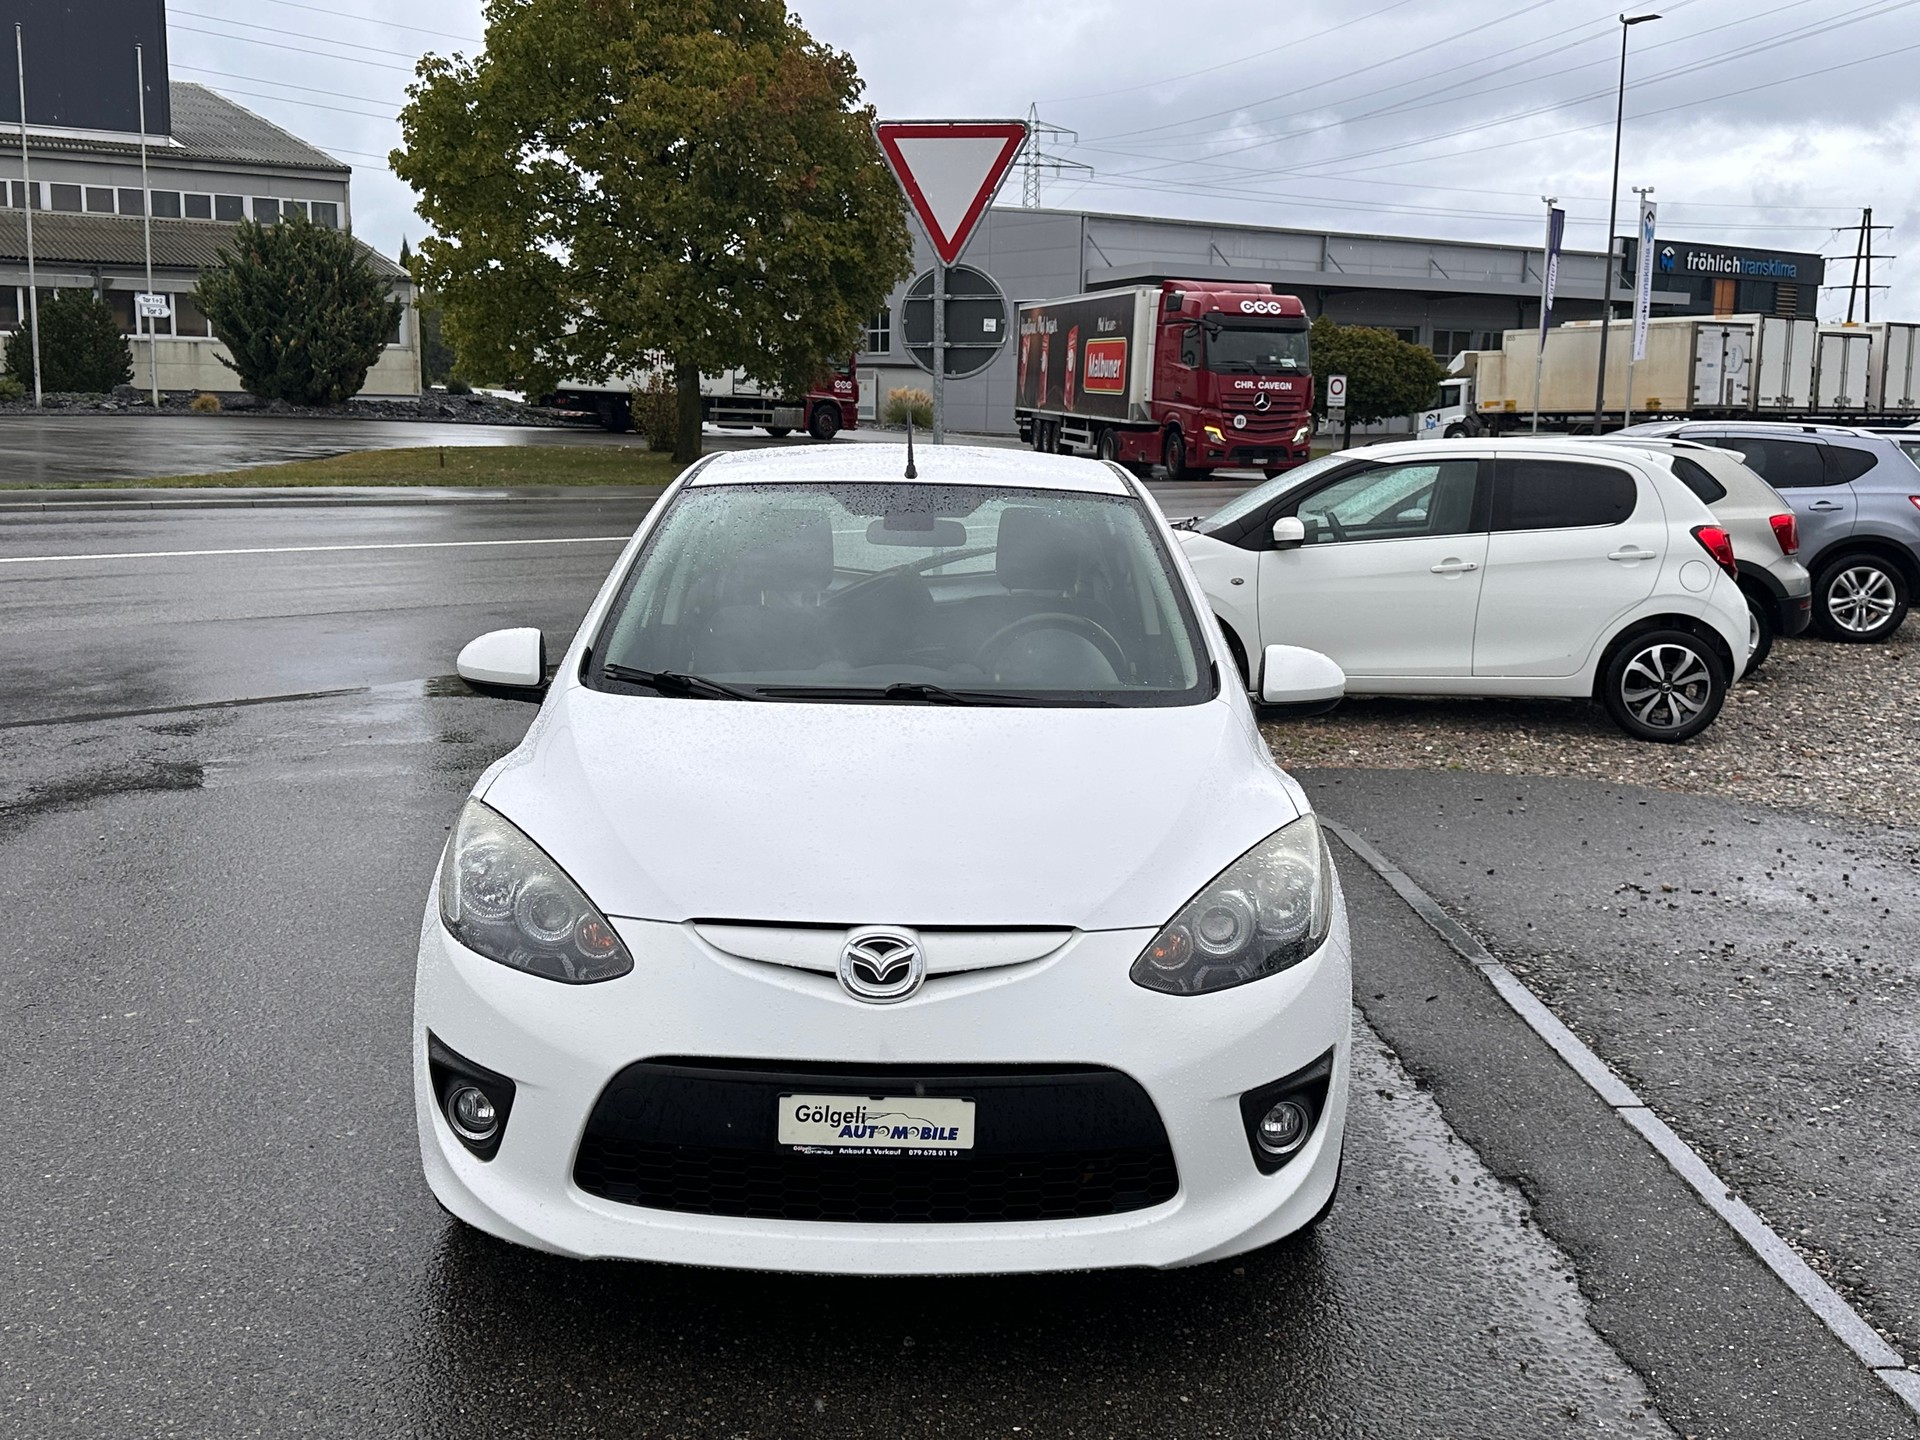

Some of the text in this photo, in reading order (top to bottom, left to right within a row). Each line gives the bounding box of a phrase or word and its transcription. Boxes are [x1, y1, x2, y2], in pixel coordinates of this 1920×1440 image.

[1687, 252, 1797, 277] fröhlichtransklima
[1240, 300, 1282, 315] CCC
[1088, 353, 1121, 378] Malbuner
[1234, 381, 1292, 390] CHR. CAVEGN
[795, 1105, 867, 1128] Gölgeli
